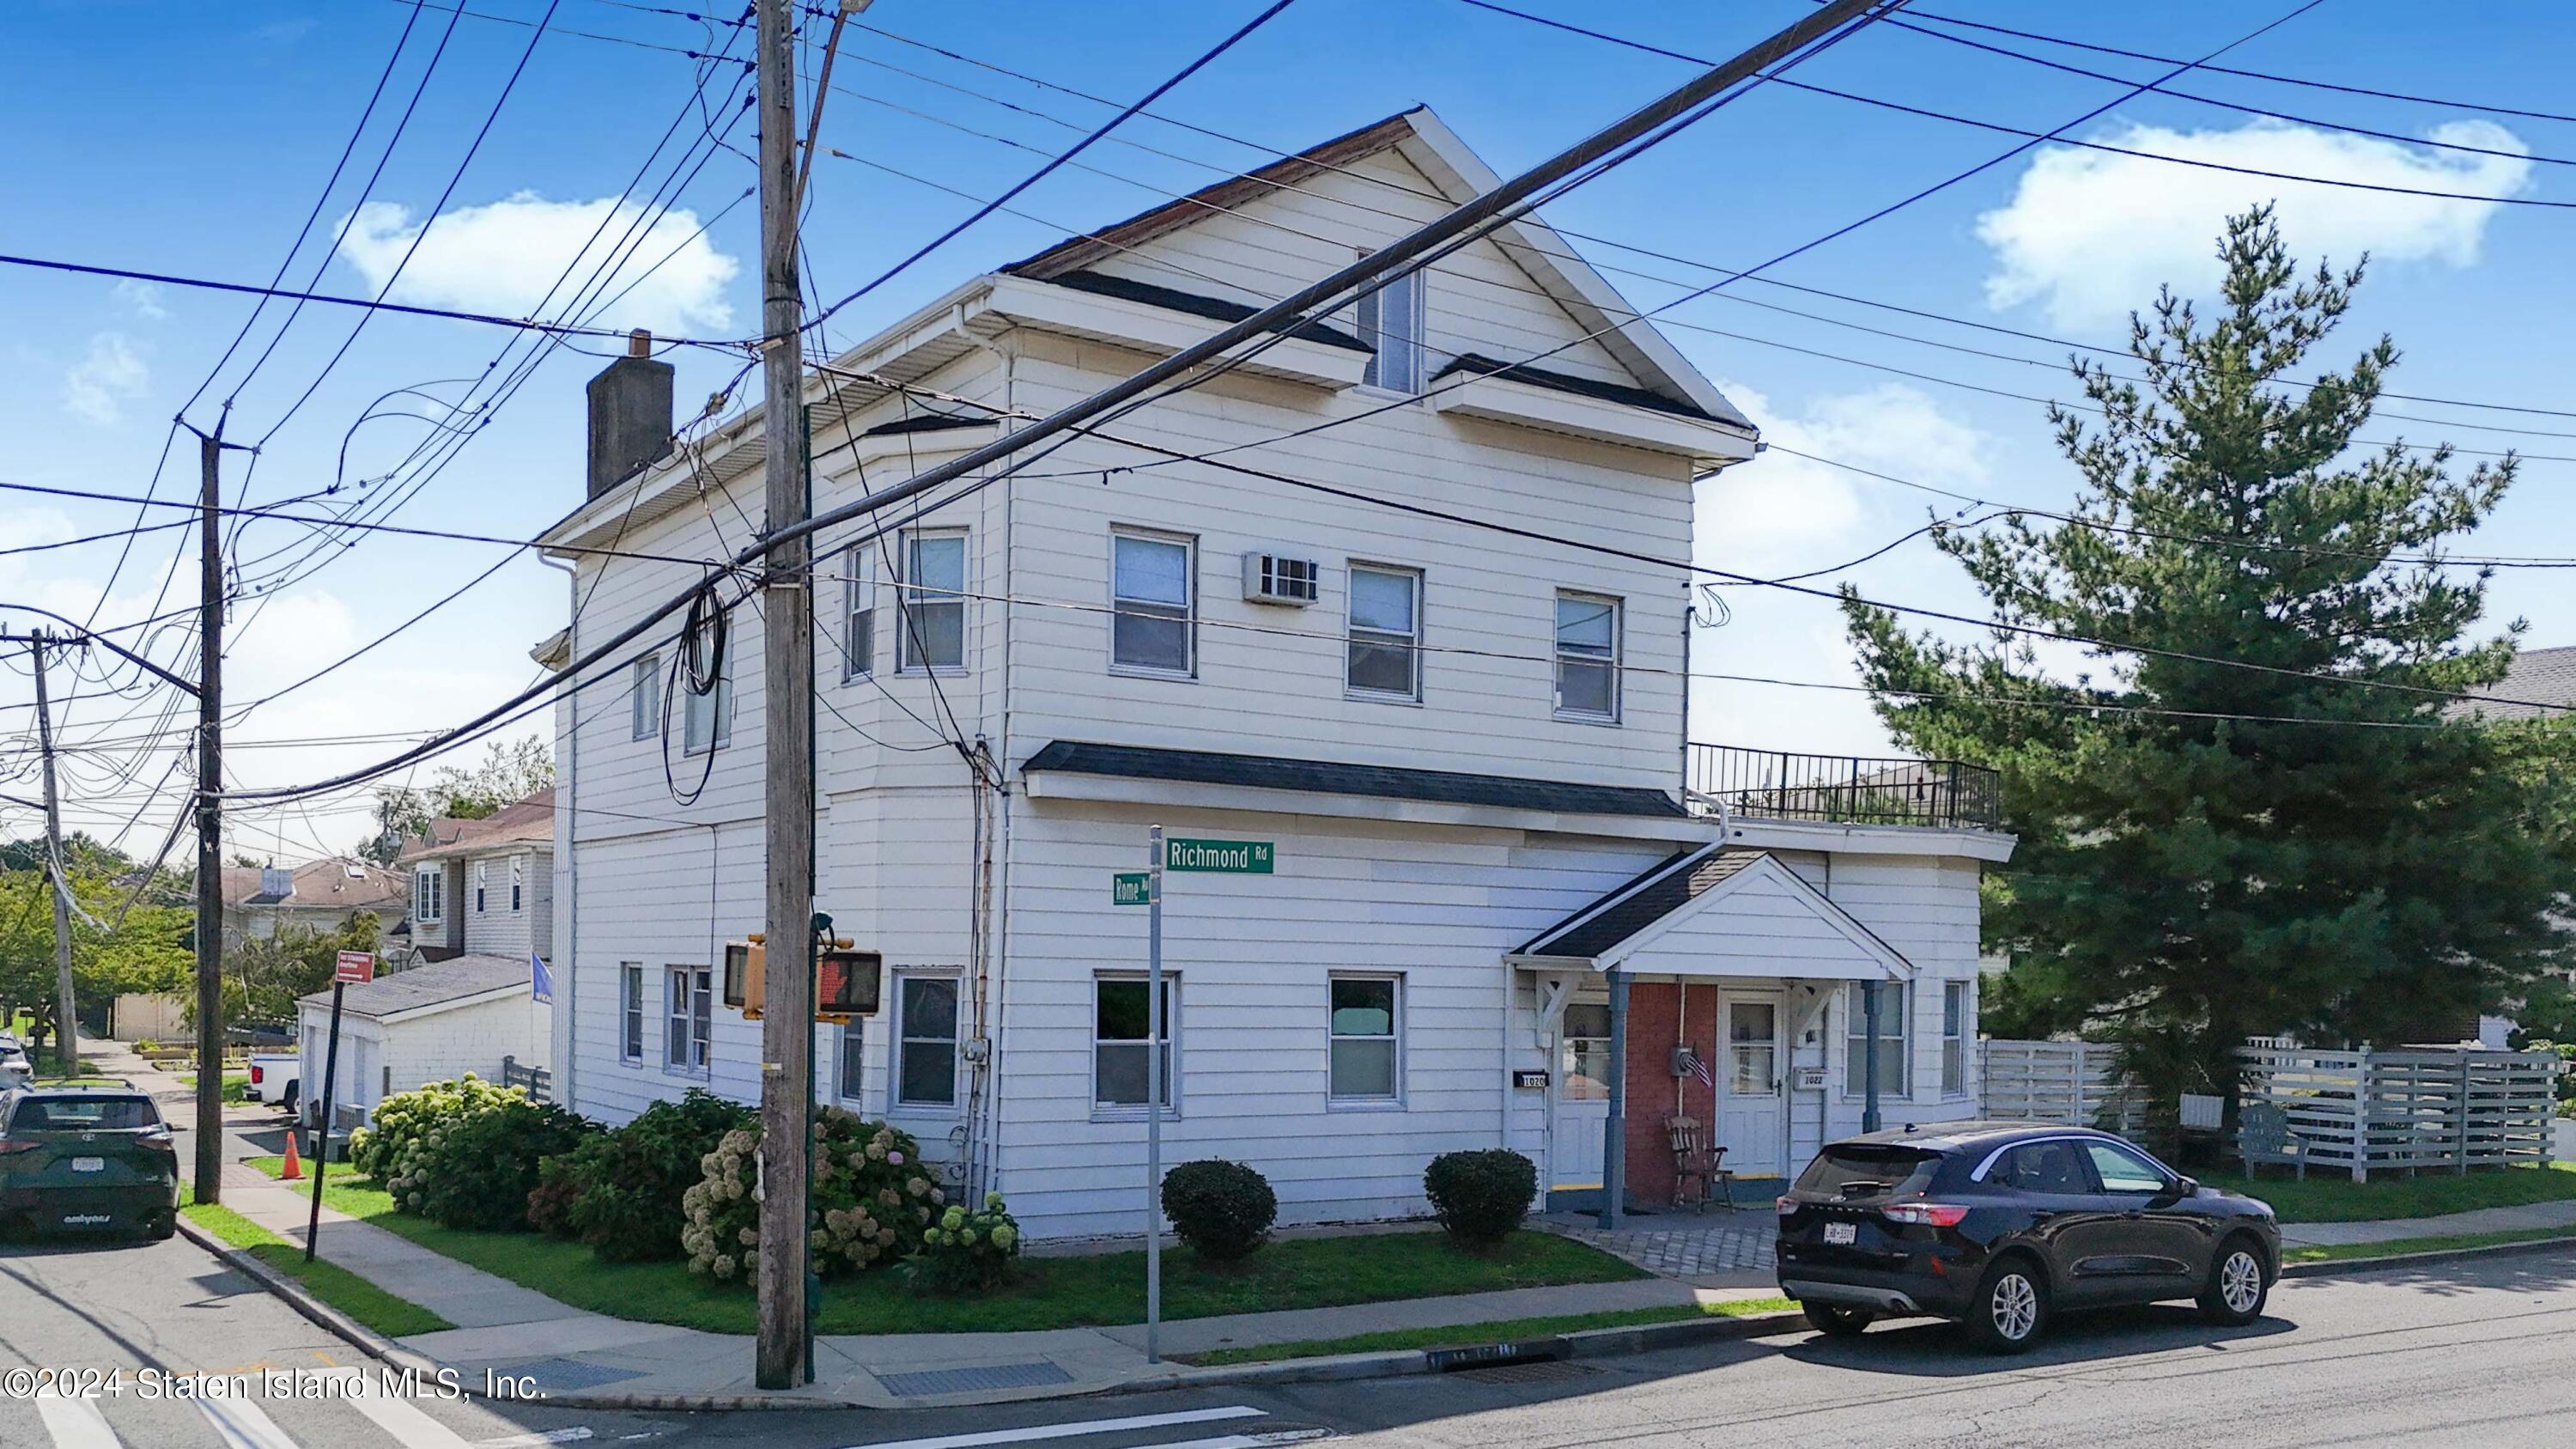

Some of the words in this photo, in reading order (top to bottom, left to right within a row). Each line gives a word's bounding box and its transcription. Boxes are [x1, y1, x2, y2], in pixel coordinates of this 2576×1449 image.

[1171, 842, 1249, 868] Richmond
[1255, 845, 1267, 861] Rd
[1115, 877, 1139, 901] Rome
[1805, 1076, 1822, 1085] 1022
